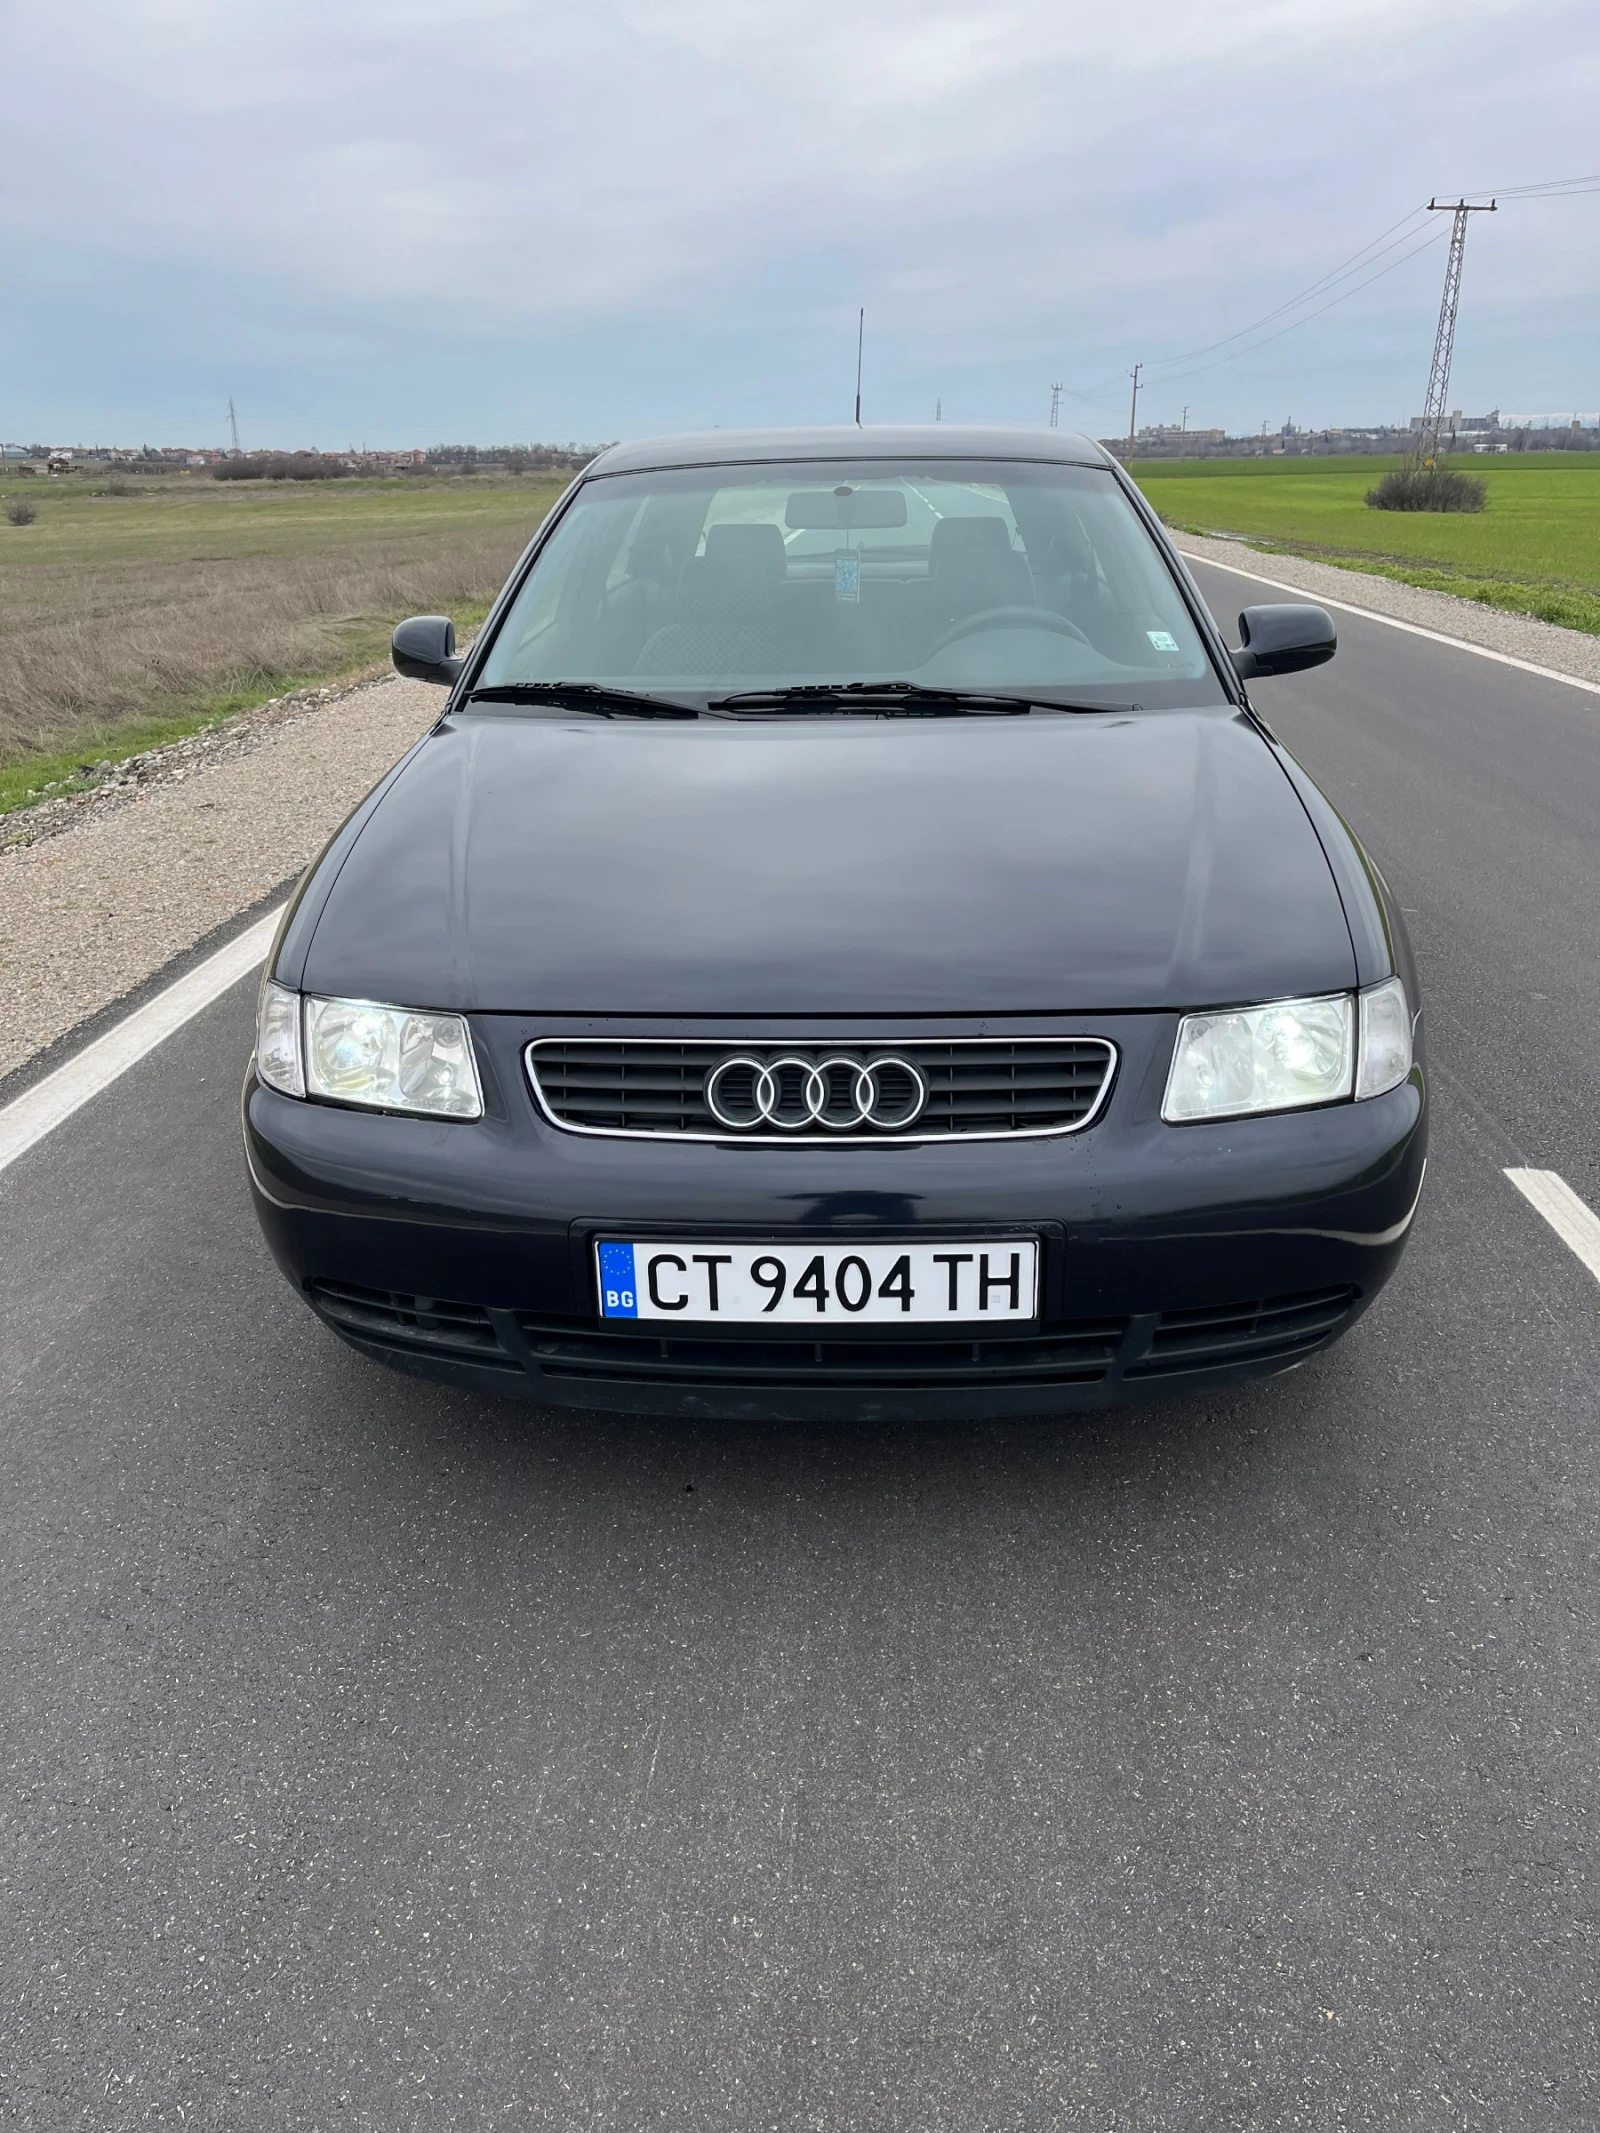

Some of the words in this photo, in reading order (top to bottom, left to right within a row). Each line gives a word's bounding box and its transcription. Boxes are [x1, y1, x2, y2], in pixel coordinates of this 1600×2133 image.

[606, 1291, 634, 1308] BG
[647, 1254, 732, 1311] CT
[750, 1255, 915, 1312] 9404
[932, 1252, 1020, 1311] TH
